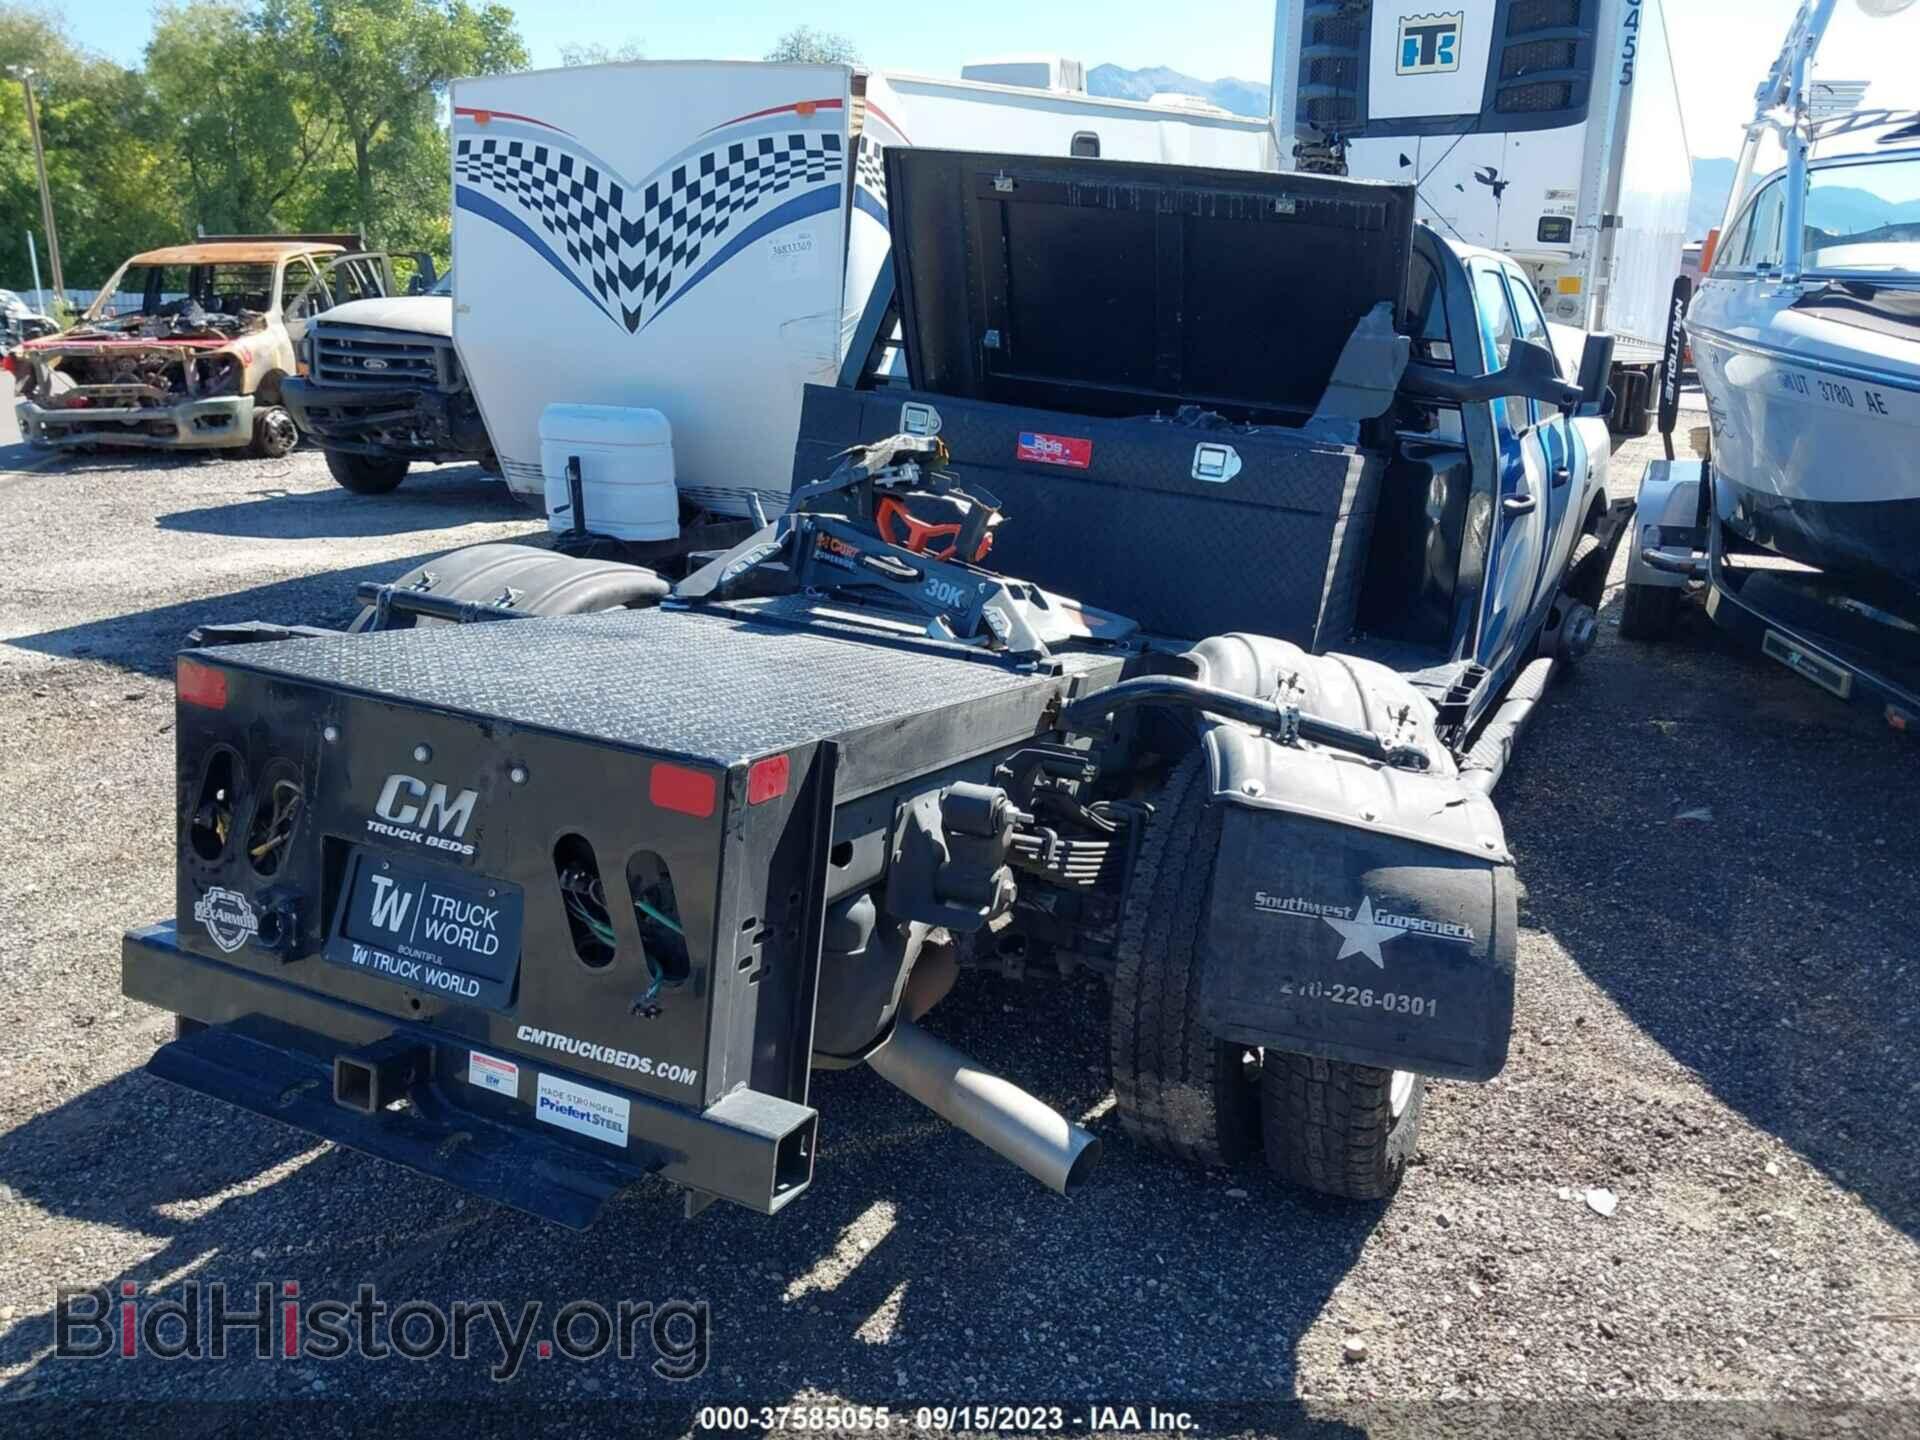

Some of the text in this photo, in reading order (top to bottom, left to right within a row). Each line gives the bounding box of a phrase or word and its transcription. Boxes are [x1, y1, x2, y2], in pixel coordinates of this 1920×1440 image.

[1619, 0, 1642, 86] 455
[1817, 380, 1854, 407] 3780
[1864, 391, 1888, 415] AE
[925, 578, 965, 608] 30K
[376, 775, 479, 837] CM
[366, 820, 475, 855] TRUCK BEDS
[371, 874, 412, 932] TW
[431, 894, 499, 930] TRUCK
[1254, 891, 1475, 938] Southwest Gooseneck
[398, 945, 443, 965] BOUNTIFUL
[425, 918, 499, 956] WORLD
[373, 952, 421, 981] TRUCK
[425, 967, 480, 997] WORLD
[517, 1025, 697, 1085] CMTRUCKBEDS.COM
